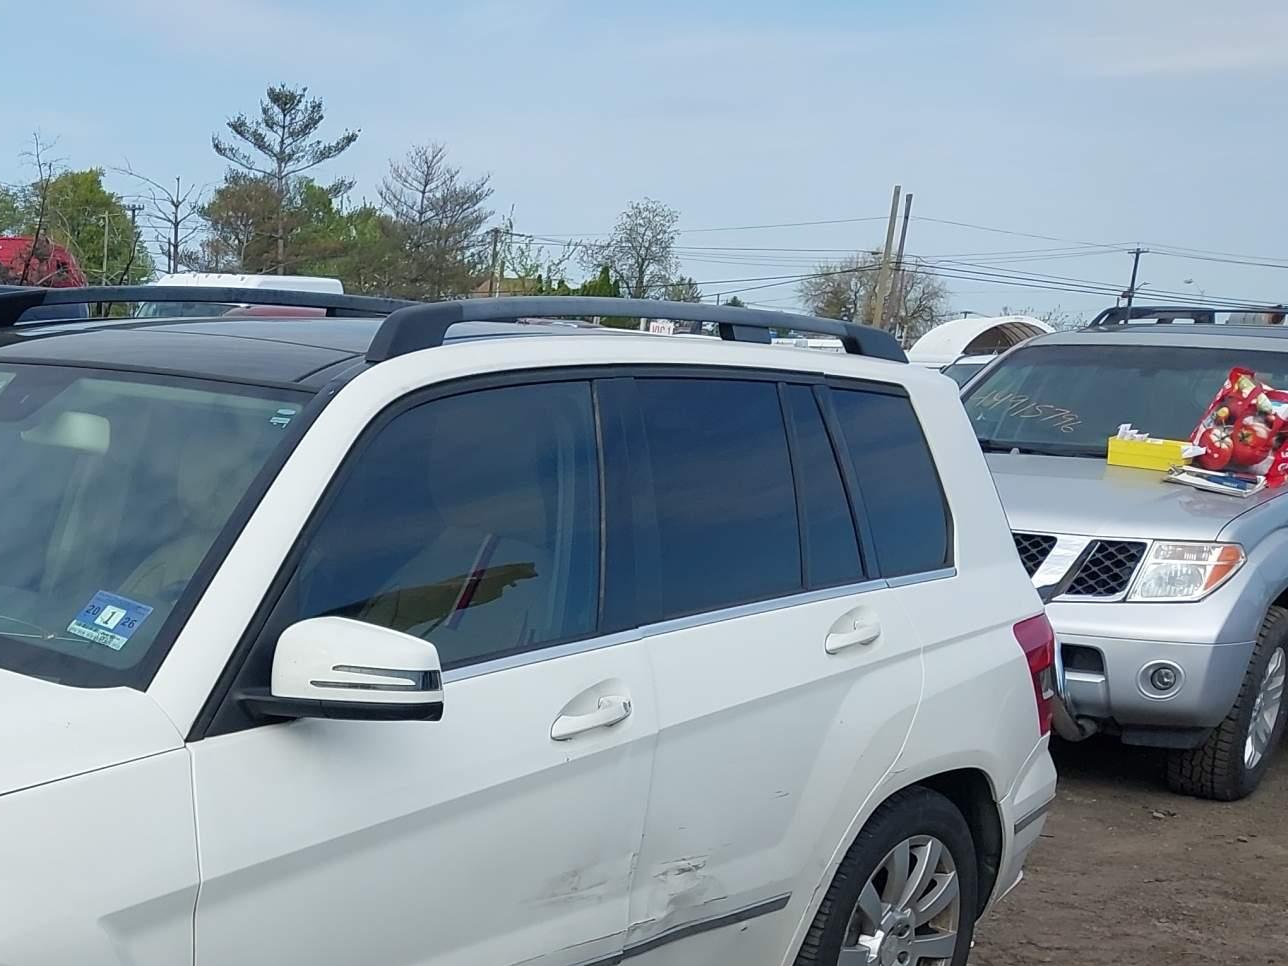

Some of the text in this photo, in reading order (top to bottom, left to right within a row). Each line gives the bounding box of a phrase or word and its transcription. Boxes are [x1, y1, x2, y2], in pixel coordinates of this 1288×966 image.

[86, 604, 137, 629] 20 1 26
